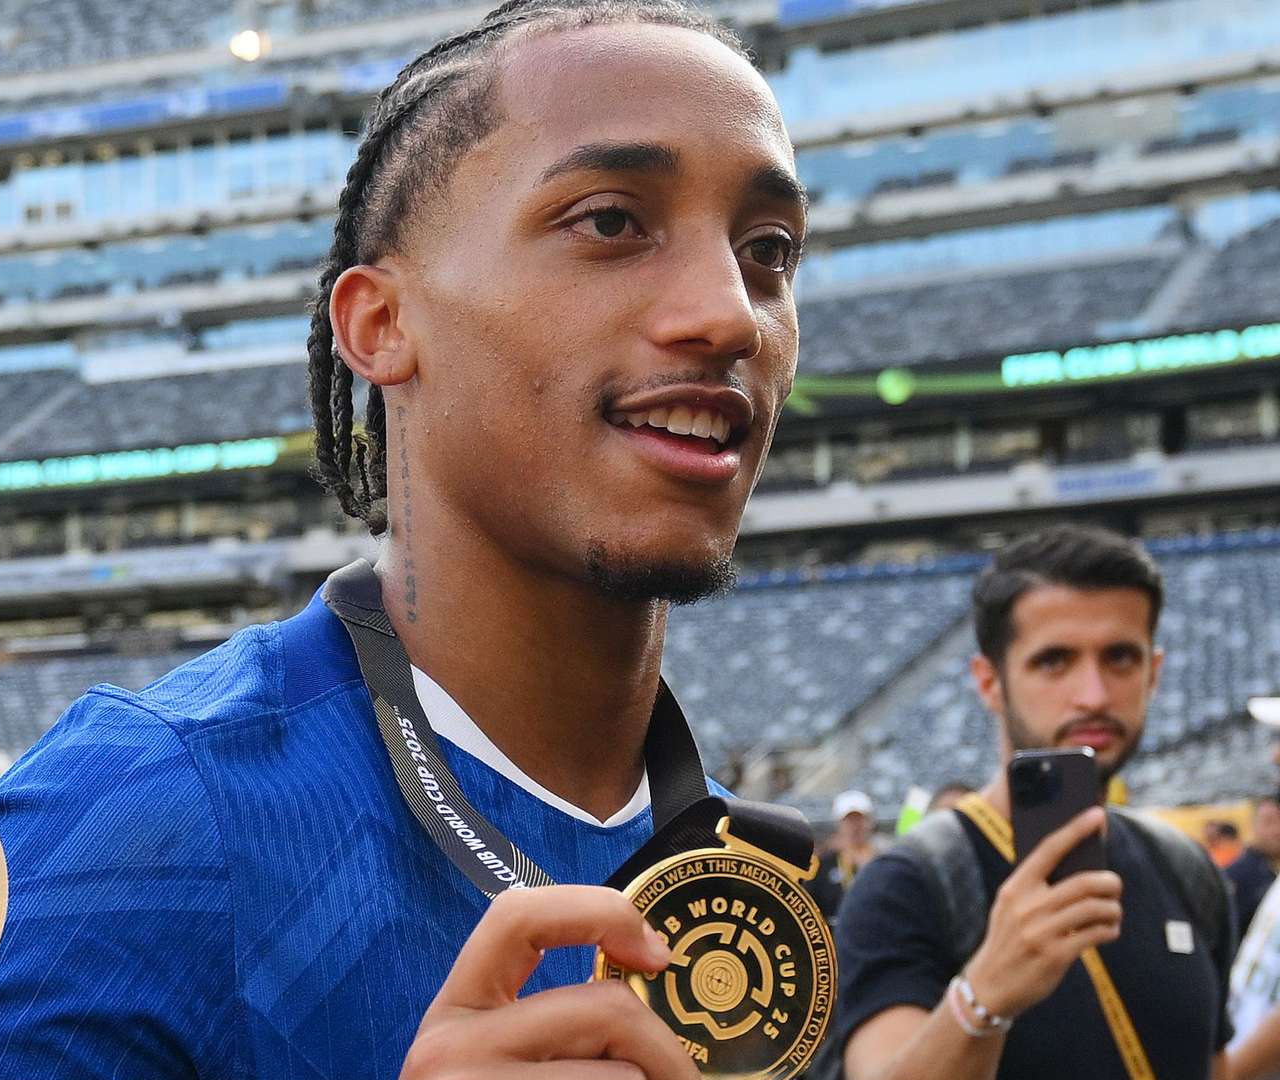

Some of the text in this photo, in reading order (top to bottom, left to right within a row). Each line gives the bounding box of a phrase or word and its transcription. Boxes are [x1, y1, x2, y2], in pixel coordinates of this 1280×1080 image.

[418, 766, 444, 802] CUP
[436, 804, 486, 851] WORLD
[476, 851, 517, 882] CLUB
[688, 897, 776, 936] WORLD
[633, 859, 831, 1066] WHO WEAR THIS MEDAL, HISTORY BELONGS TO YOU
[775, 944, 797, 998] CUP
[763, 1007, 789, 1040] 25
